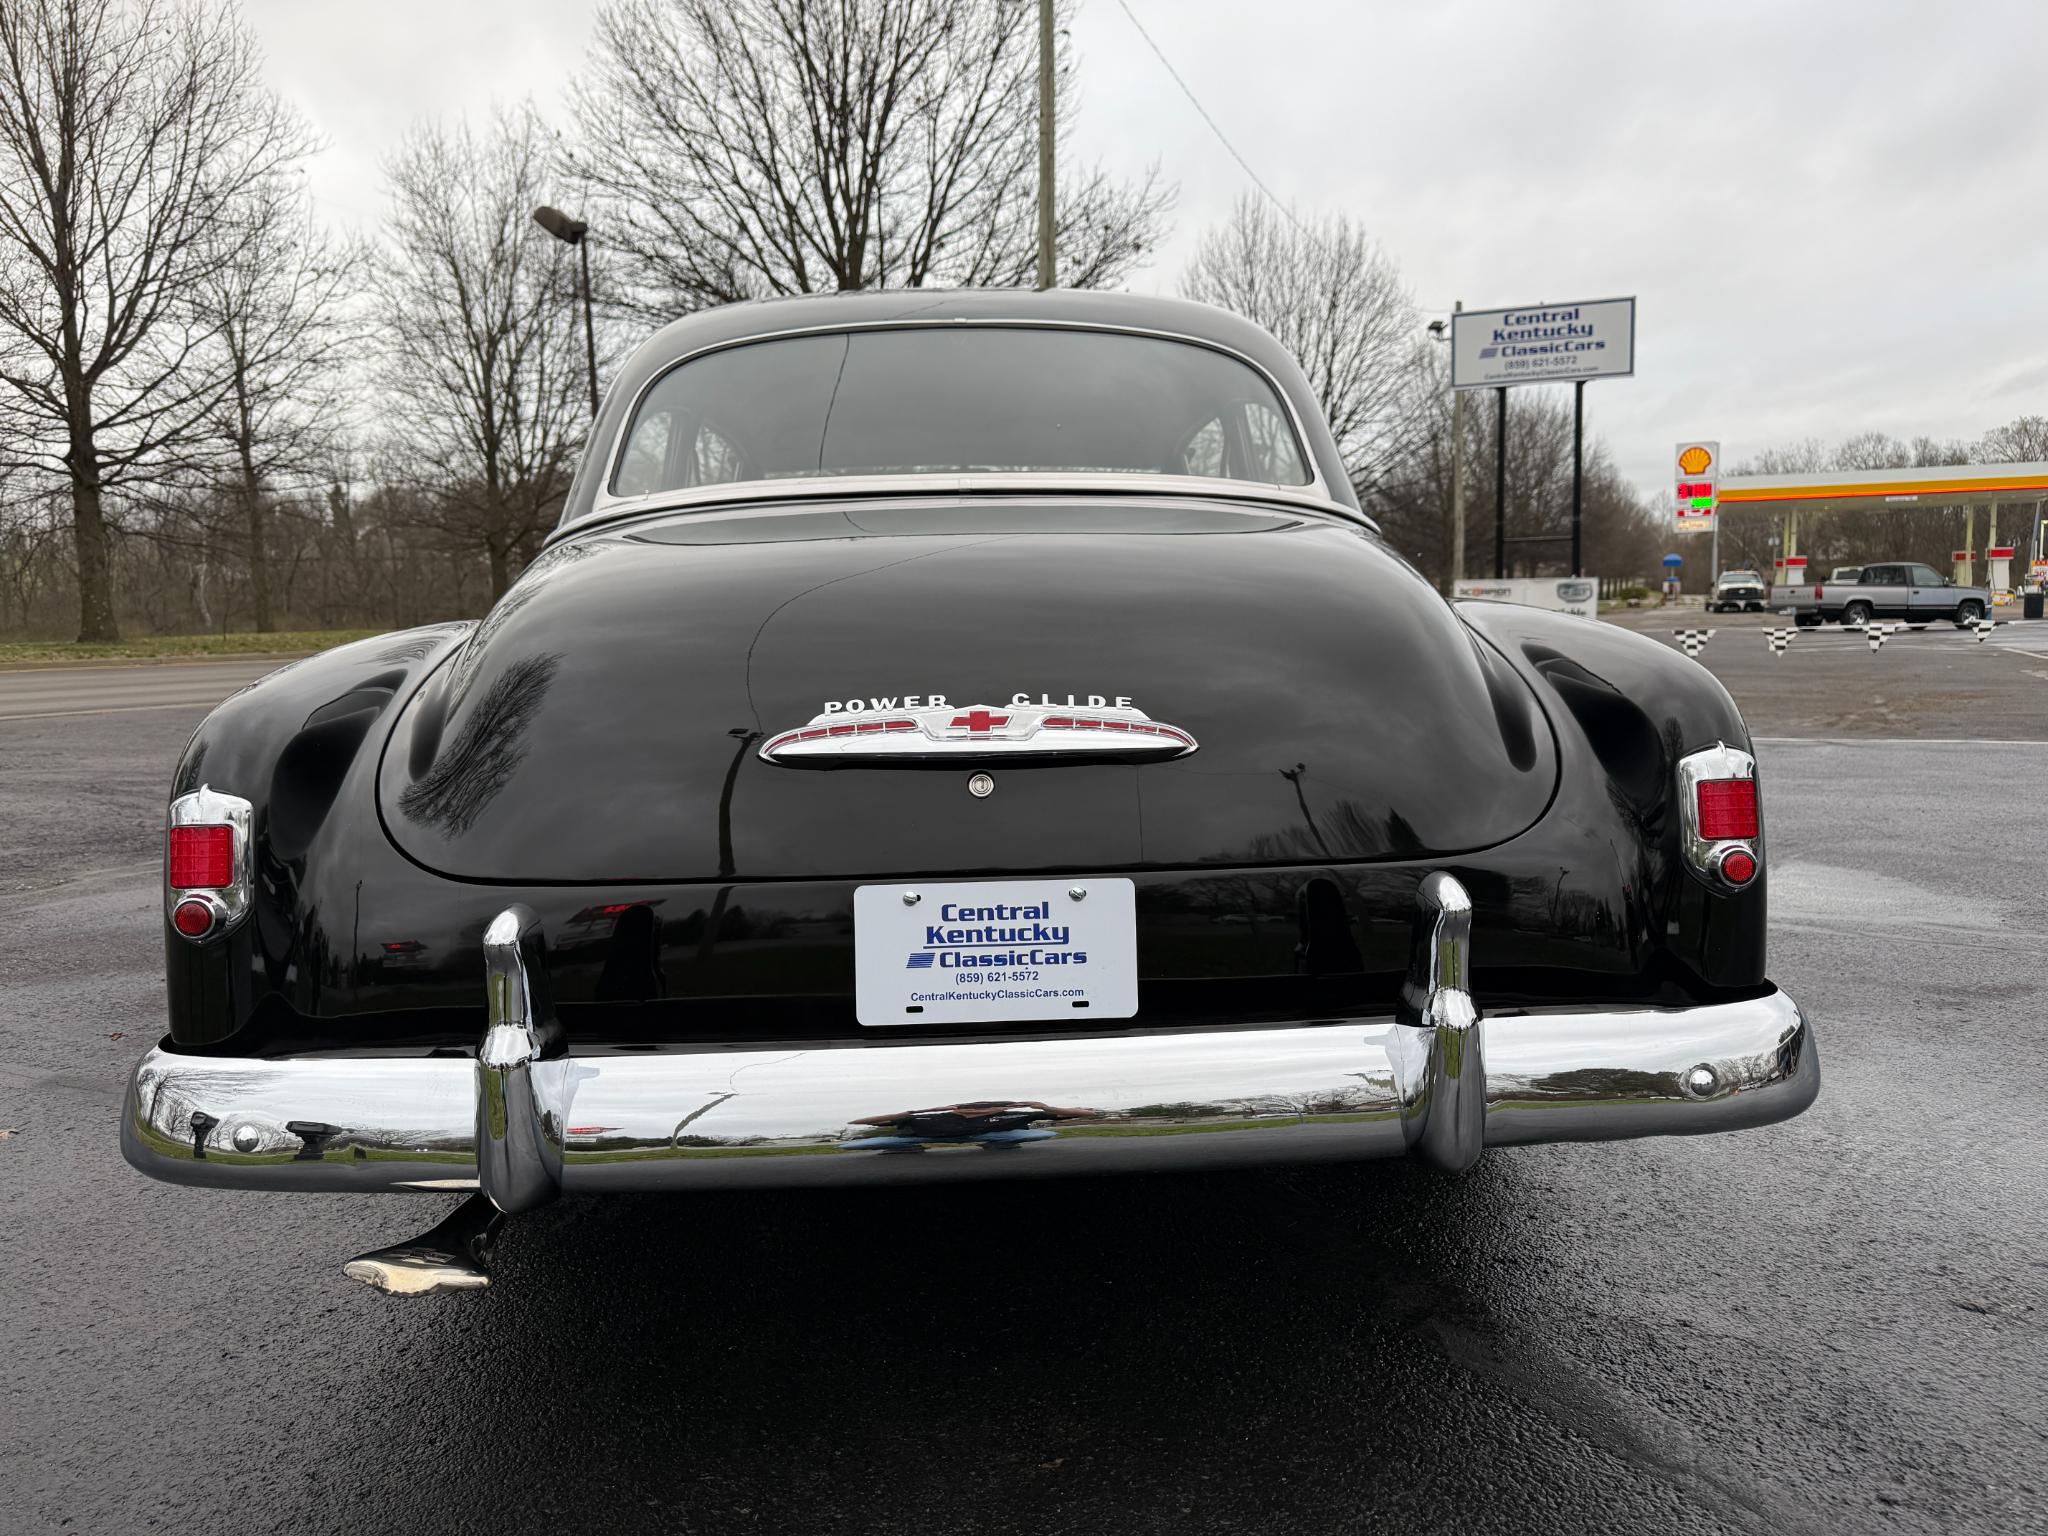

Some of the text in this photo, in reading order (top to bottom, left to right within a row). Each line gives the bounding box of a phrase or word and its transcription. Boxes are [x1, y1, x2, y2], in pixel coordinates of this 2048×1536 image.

[1503, 308, 1580, 327] Central
[1493, 323, 1594, 342] Kentucky
[1501, 339, 1605, 358] ClassicCars
[1532, 355, 1578, 368] 621-5572
[824, 692, 1134, 715] POWER GLIDE
[941, 901, 1050, 922] Central
[926, 923, 1070, 945] Kentucky
[939, 949, 1088, 968] ClassicCars
[955, 971, 1039, 985] (859) 621-5572
[910, 988, 1085, 1002] CentralKentuckyClassicCars.com
